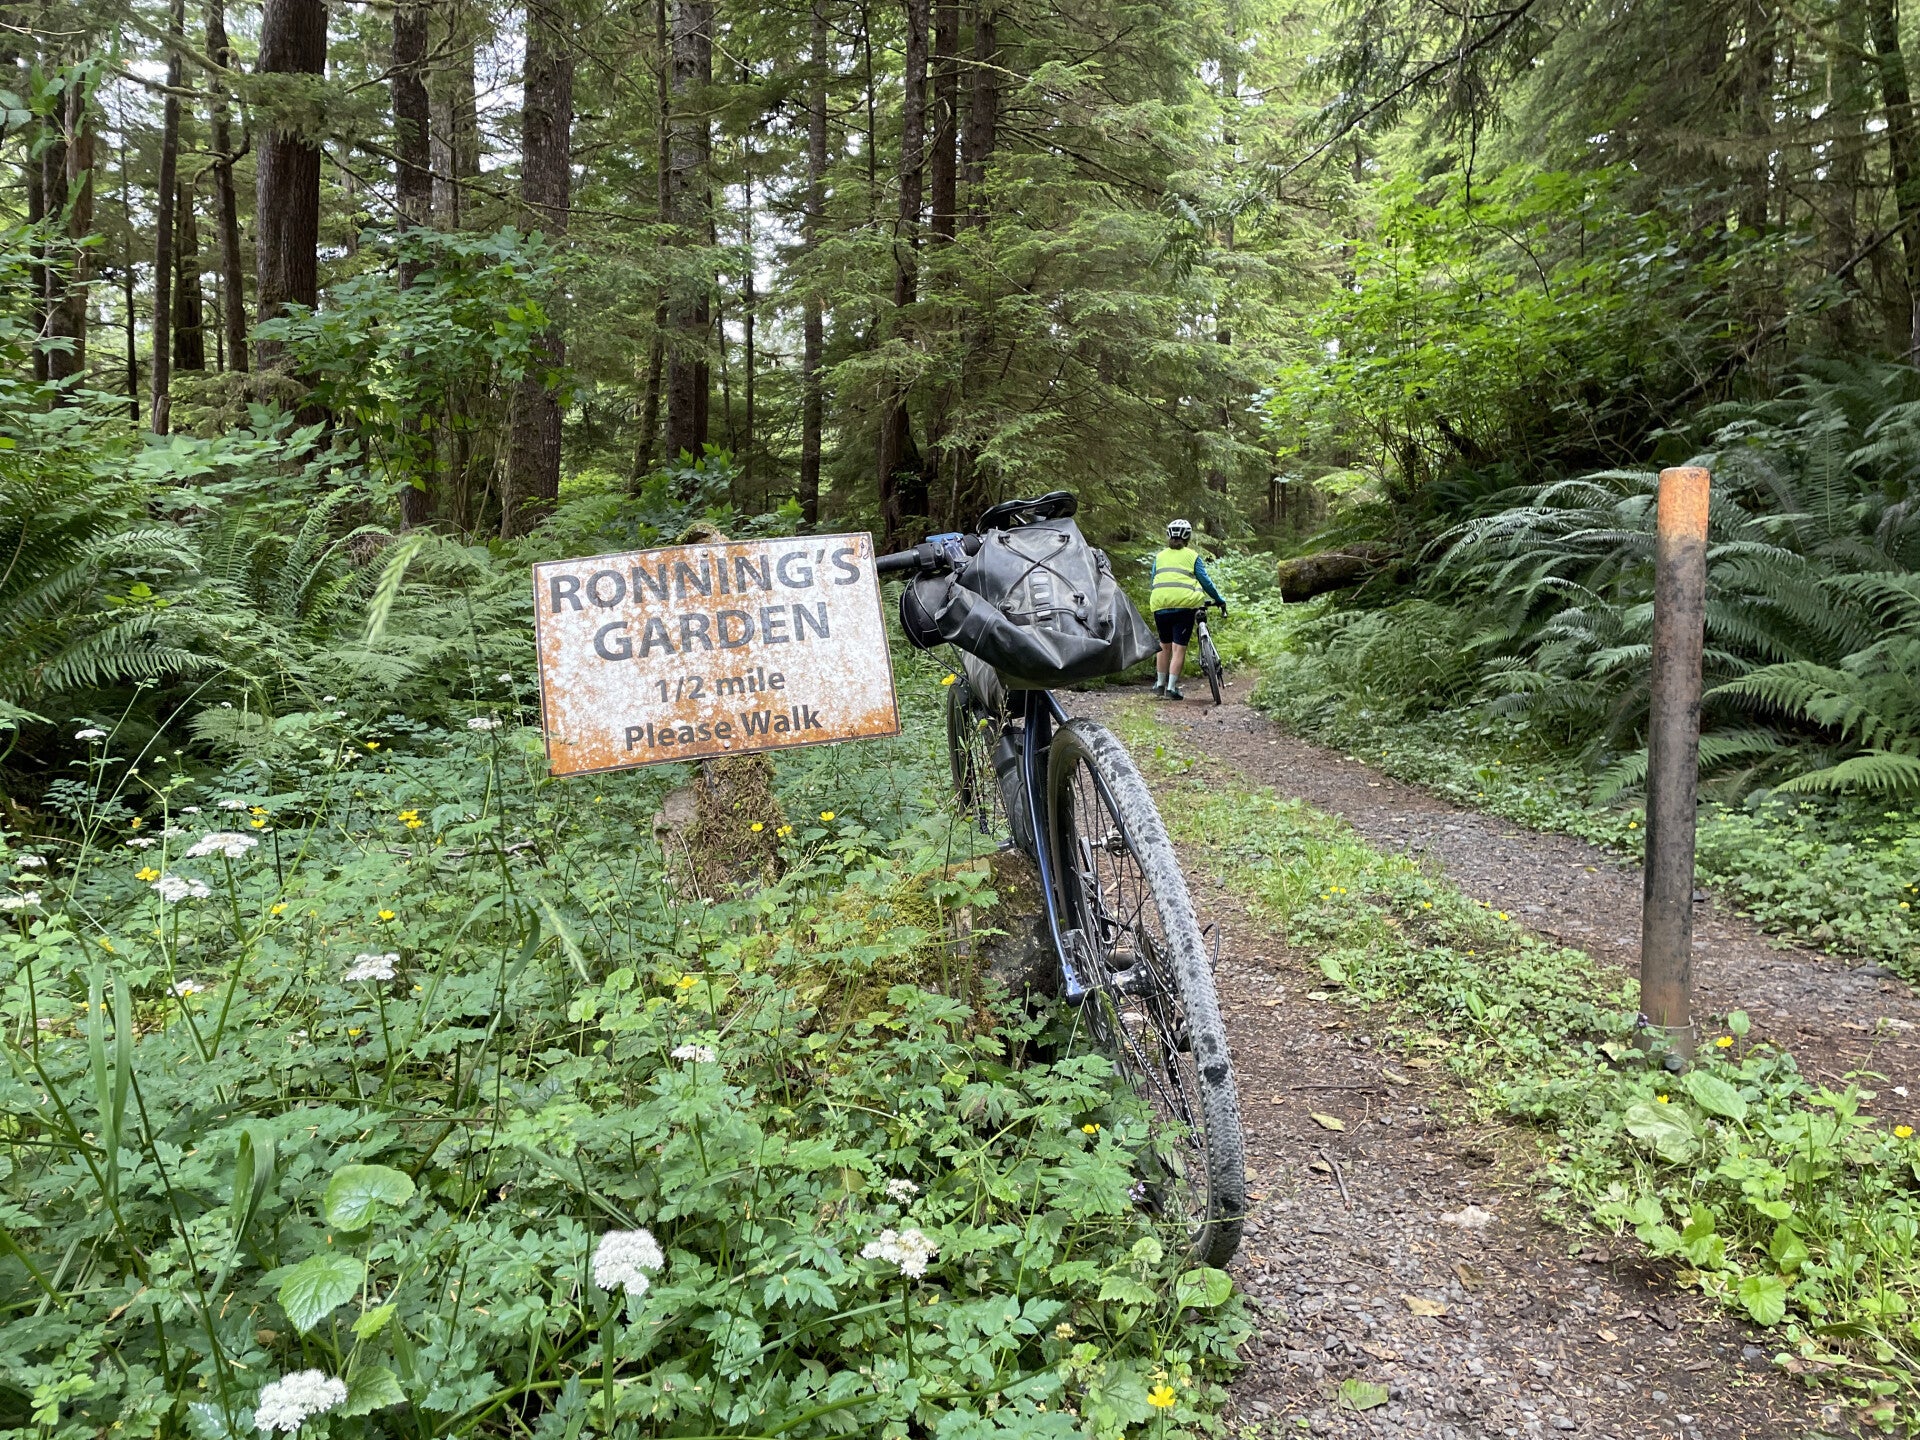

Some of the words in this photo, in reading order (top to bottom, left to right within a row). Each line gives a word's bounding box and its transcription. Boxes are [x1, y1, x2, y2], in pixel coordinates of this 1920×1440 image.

[550, 547, 861, 613] RONNING'S
[593, 602, 831, 661] GARDEN
[655, 675, 706, 703] 1/2
[716, 667, 786, 696] mile
[625, 721, 733, 751] Please
[740, 704, 823, 736] Walk
